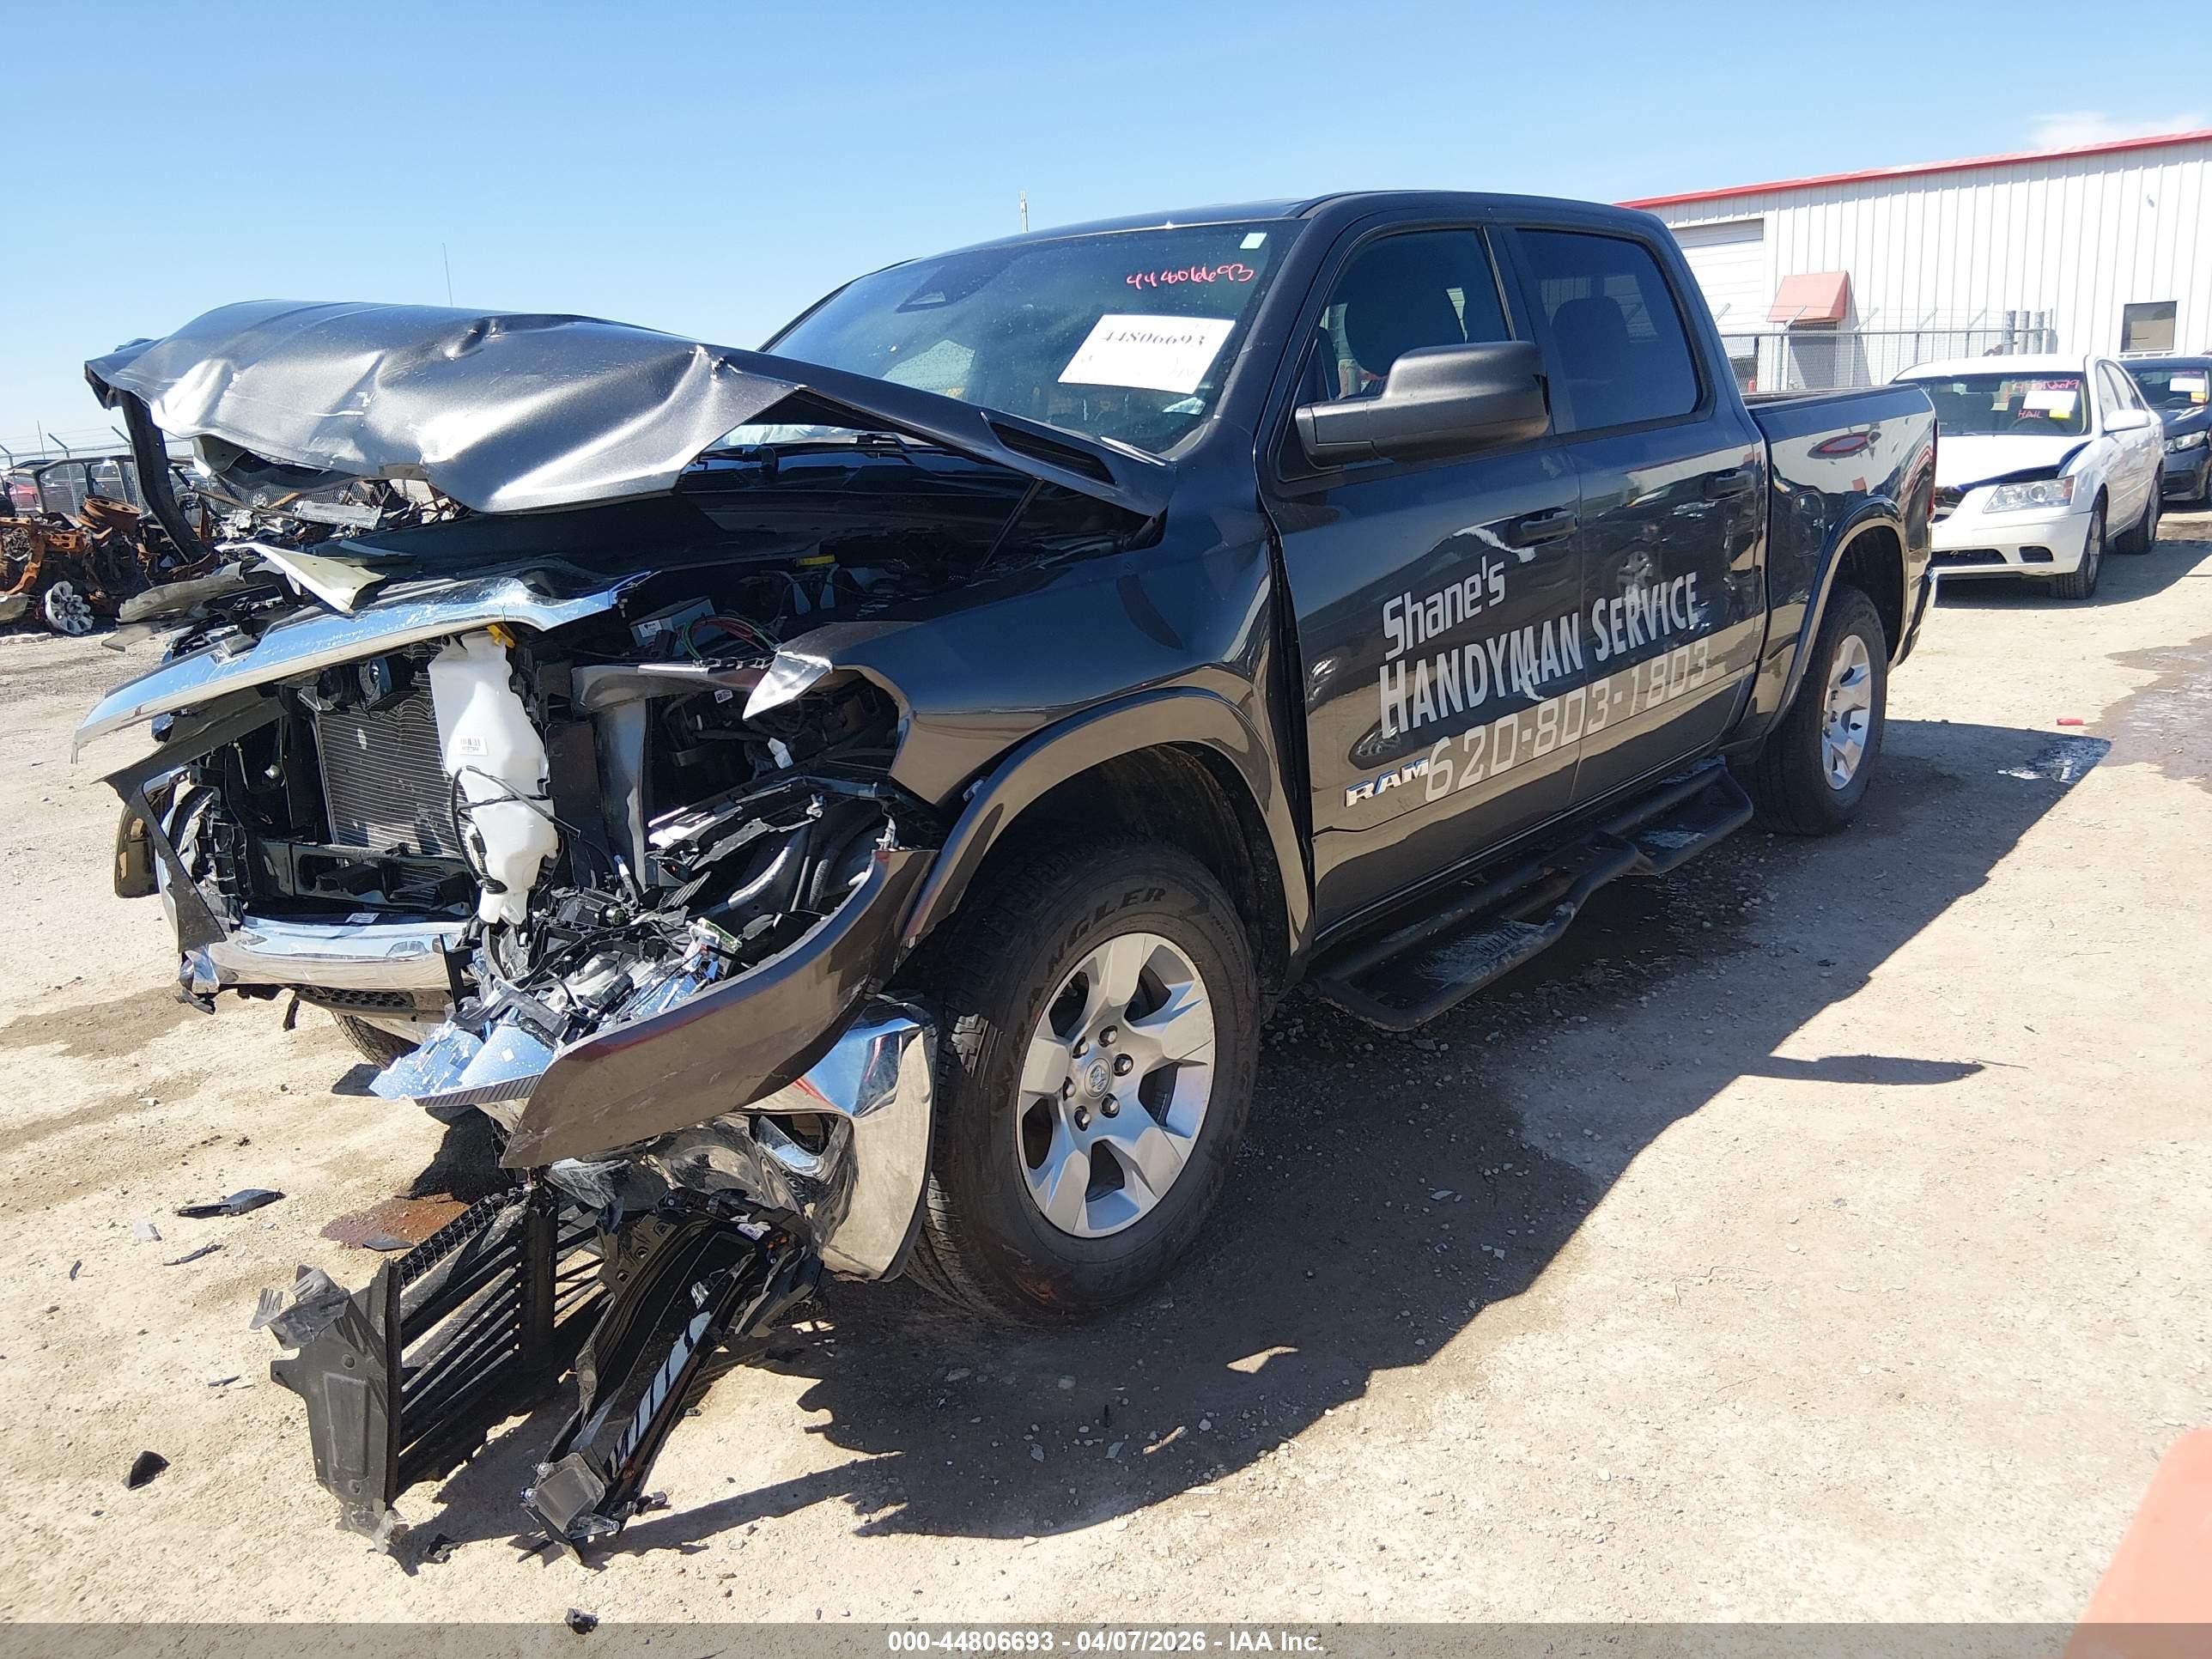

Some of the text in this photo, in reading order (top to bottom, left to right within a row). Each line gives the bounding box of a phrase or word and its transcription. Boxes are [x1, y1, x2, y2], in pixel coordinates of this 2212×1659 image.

[2018, 410, 2044, 419] HAIL
[1378, 571, 1701, 739] HANDYMAN SERVICE
[1382, 556, 1505, 661] Shane's
[1425, 636, 1710, 803] 620-803-1803
[1345, 757, 1430, 808] RAM
